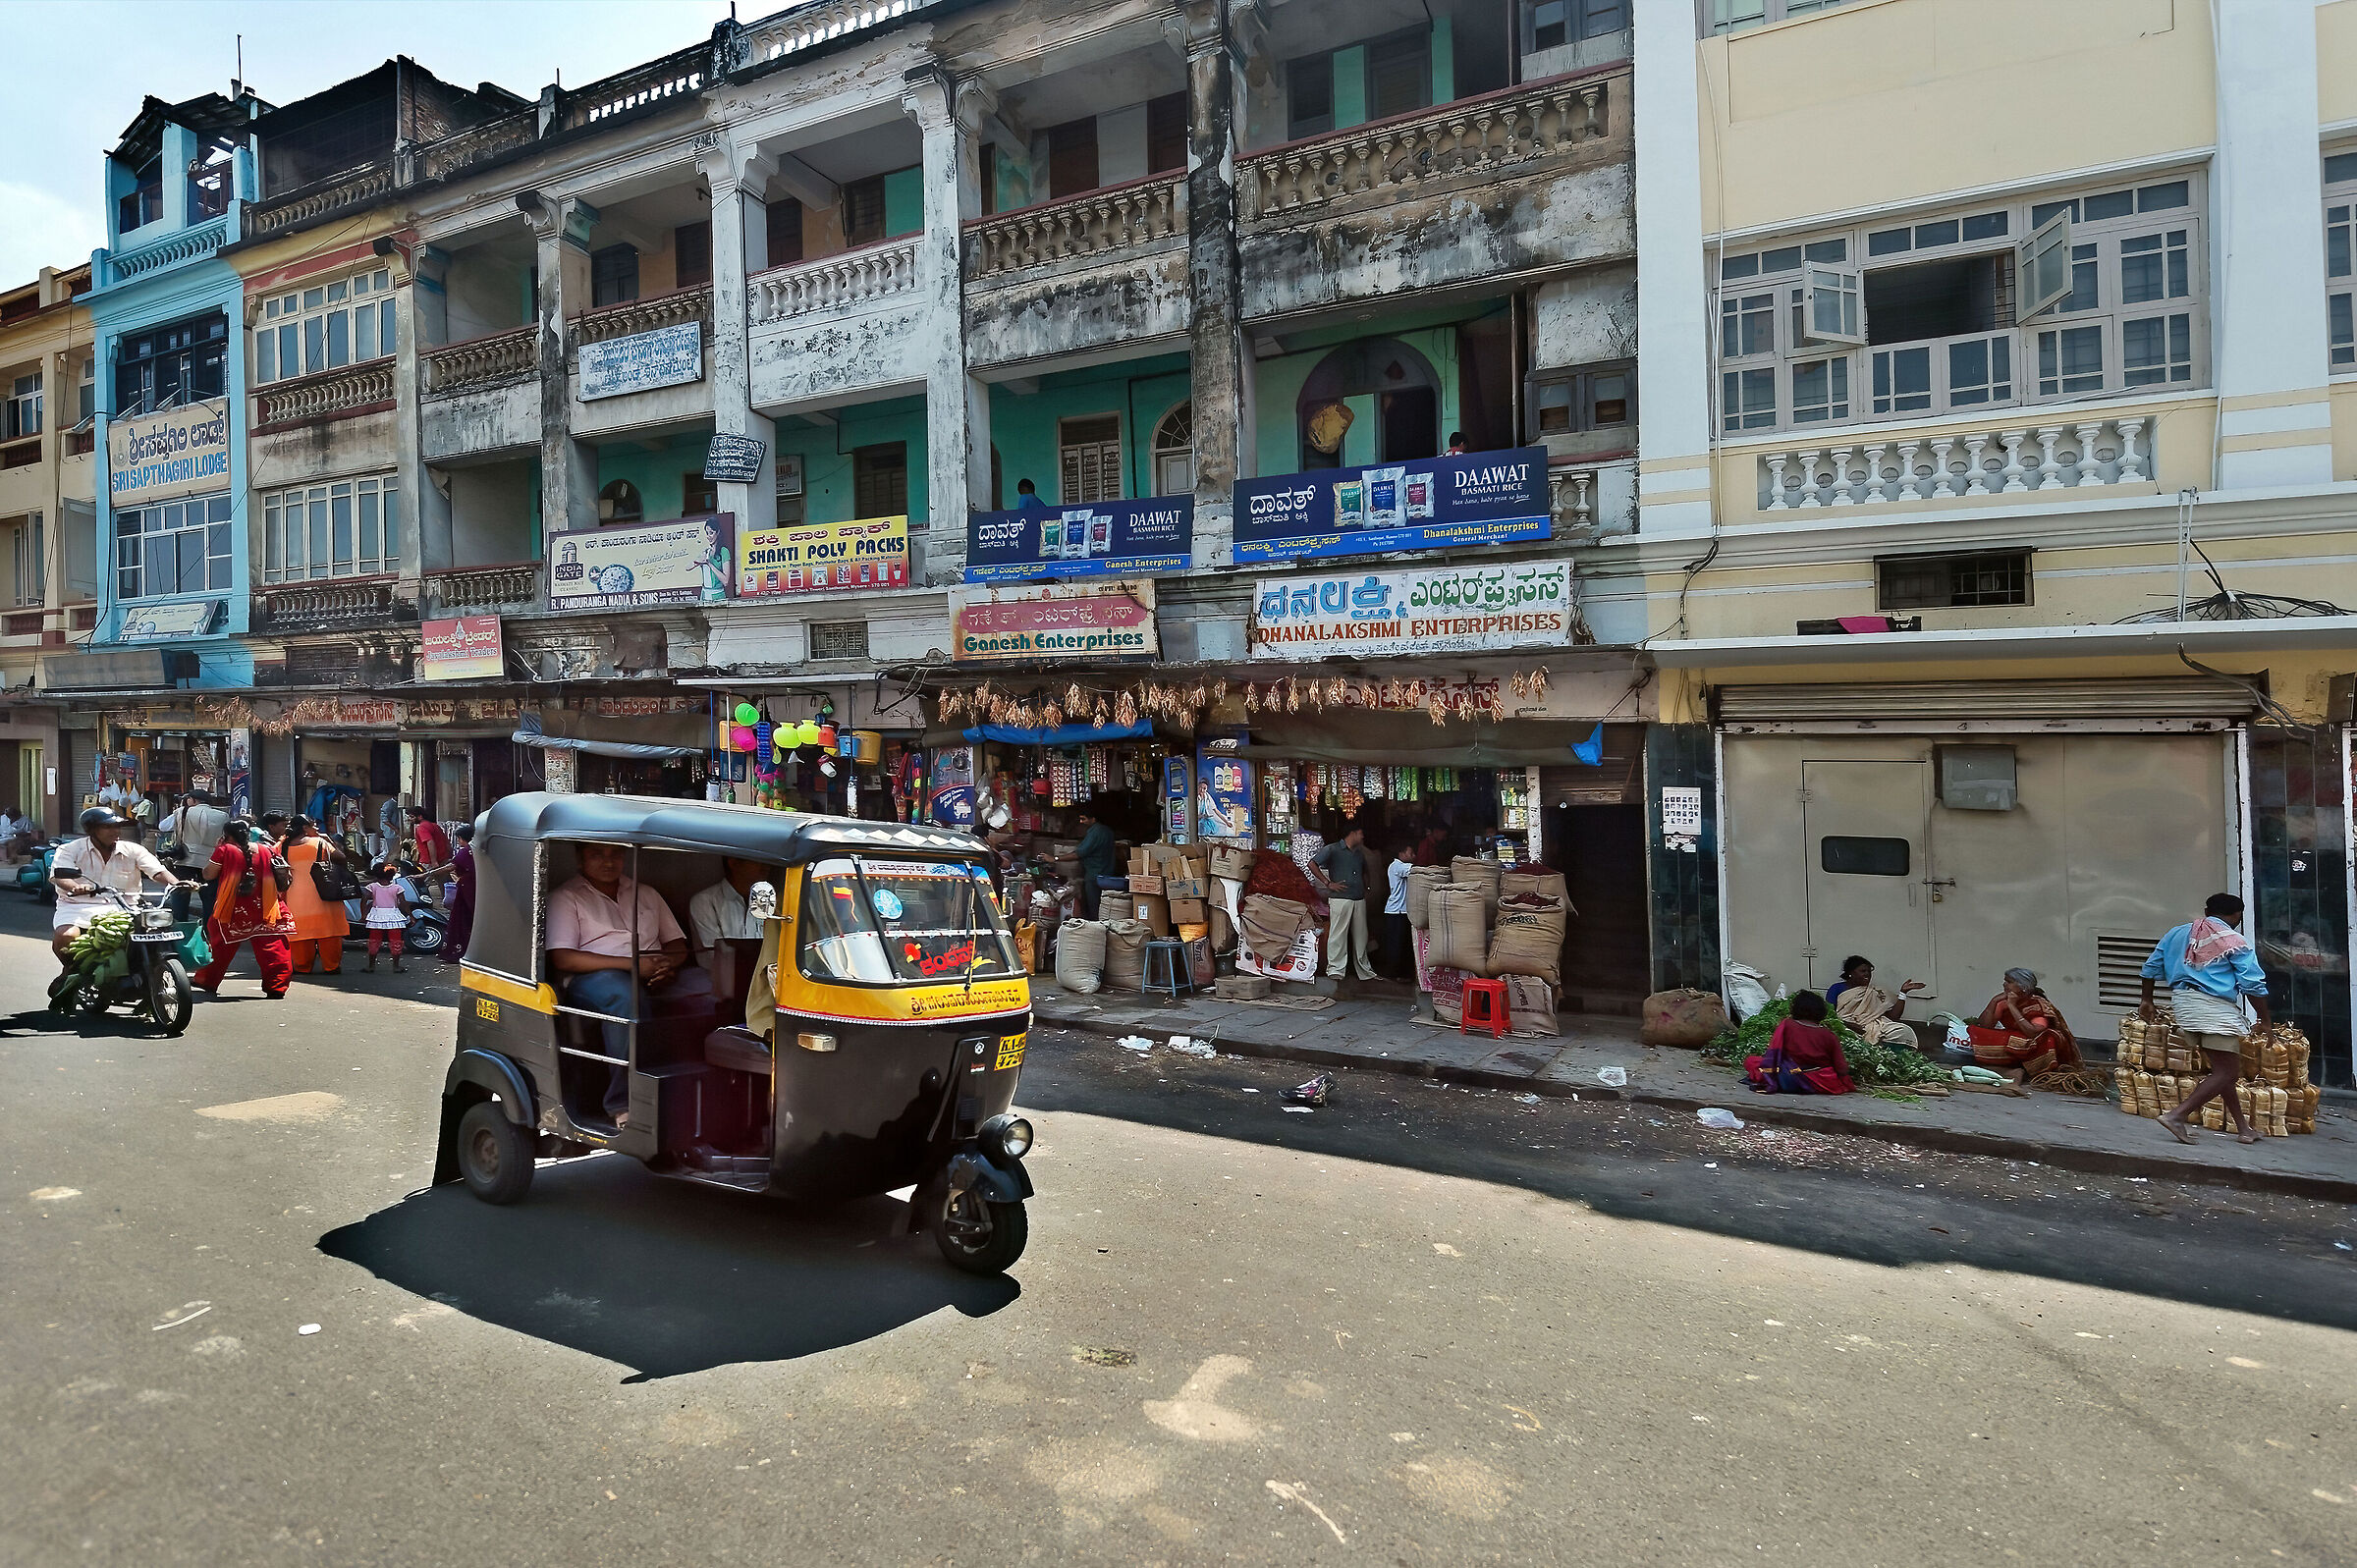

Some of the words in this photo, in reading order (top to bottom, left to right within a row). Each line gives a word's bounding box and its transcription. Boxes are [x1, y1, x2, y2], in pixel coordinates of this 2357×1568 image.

[194, 452, 228, 478] LODGE
[1454, 463, 1529, 487] DAAWAT
[1250, 484, 1316, 514] ದಾವತ್
[1461, 484, 1500, 495] BASMATI
[1503, 482, 1522, 491] RICE
[978, 517, 1026, 540] ದಾವತ್
[1129, 511, 1181, 527] DAAWAT
[1424, 524, 1485, 539] Dhanalakshmi
[1488, 521, 1539, 533] Enterprises
[789, 529, 829, 542] ಪಾಲಿ
[838, 520, 891, 539] ಪ್ಯಾಕ್
[748, 546, 798, 565] SHAKTI
[807, 541, 847, 560] POLY
[856, 536, 905, 555] PACKS
[1135, 558, 1181, 568] Enterprises
[551, 600, 559, 610] R.
[560, 595, 608, 609] PANDURANGA
[609, 593, 630, 607] NADIA
[631, 593, 638, 605] &
[639, 591, 659, 604] SONS
[1258, 621, 1401, 643] DHANALAKSHMI
[1411, 613, 1562, 637] ENTERPRISES
[963, 633, 1031, 652] Ganesh
[1034, 627, 1143, 651] Enterprises
[470, 645, 498, 657] Traders
[1428, 974, 1462, 985] CHINA
